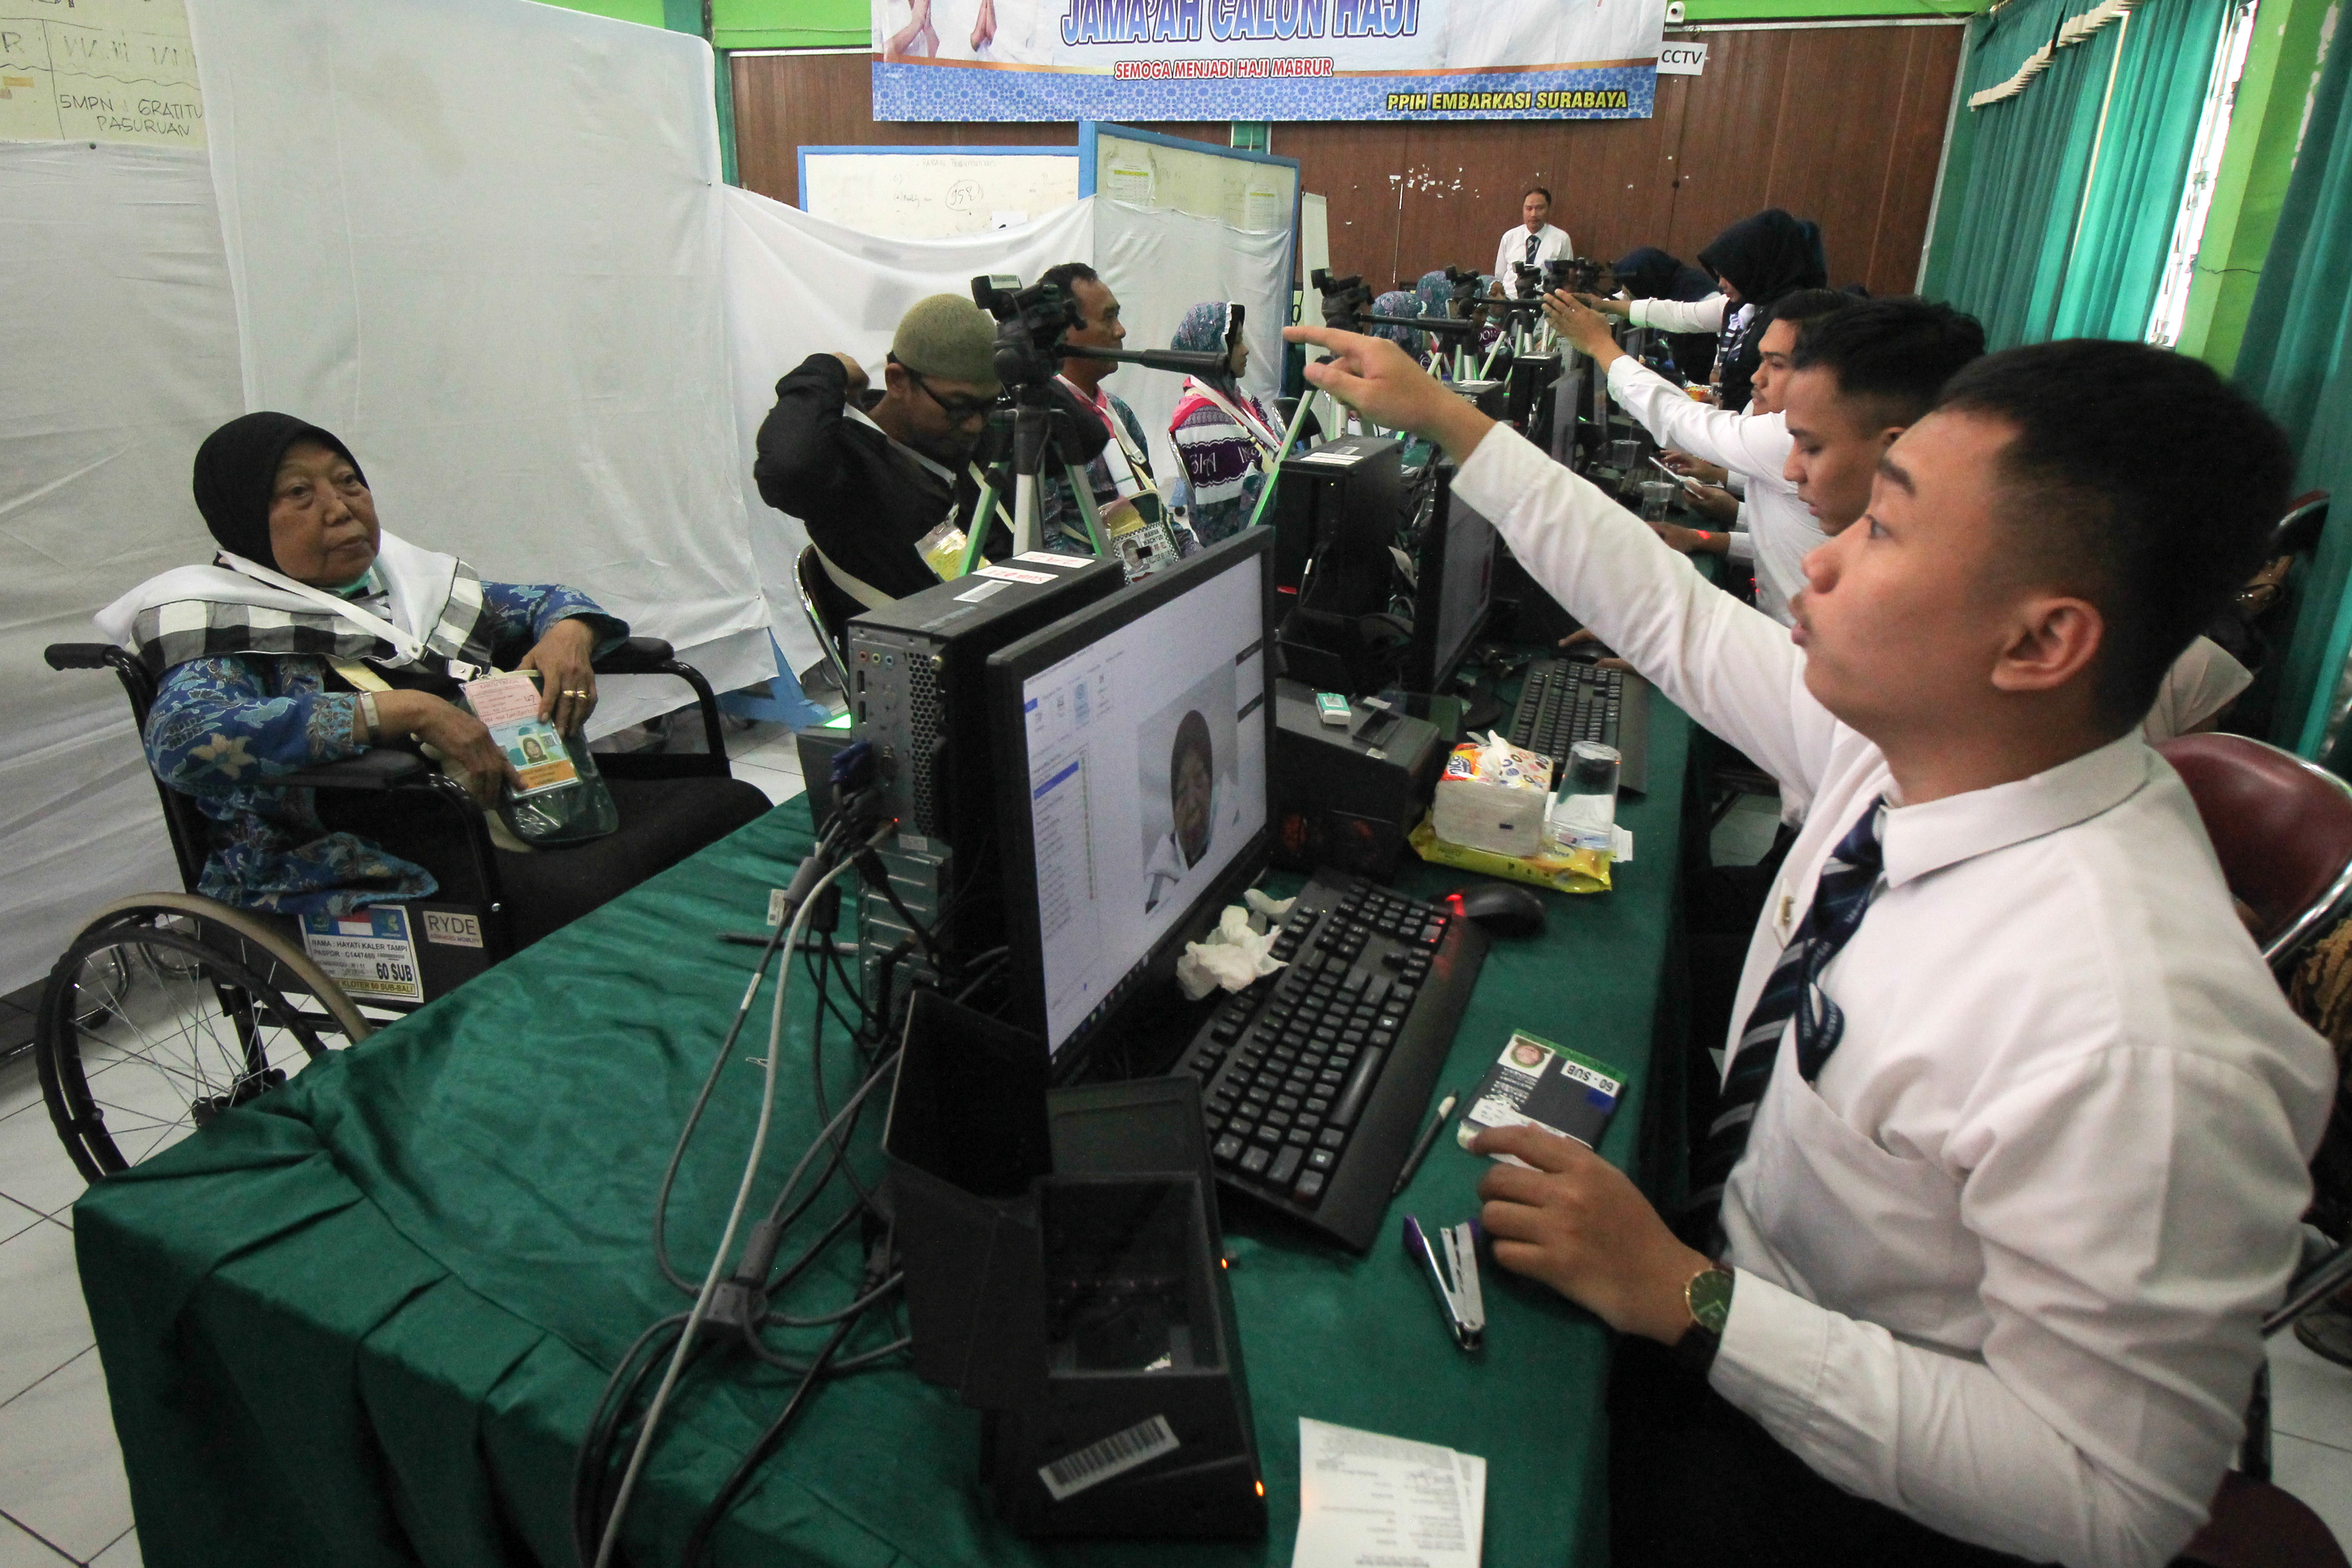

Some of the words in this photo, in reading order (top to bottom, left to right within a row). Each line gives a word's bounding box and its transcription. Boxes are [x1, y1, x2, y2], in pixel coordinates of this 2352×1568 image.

[1061, 0, 1201, 46] JAMA'AH
[1208, 0, 1324, 42] CALON
[1332, 0, 1418, 38] HAJI
[1661, 49, 1702, 66] CCTV
[1114, 60, 1172, 80] SEMOGA
[1174, 59, 1234, 79] MENJADI
[1236, 58, 1270, 78] HAJI
[1271, 56, 1334, 77] MABRUR
[1387, 93, 1428, 111] PPIH
[1431, 92, 1533, 111] EMBARKASI
[1535, 91, 1628, 110] SURABAYA
[97, 116, 189, 137] PASURUAN
[427, 915, 477, 935] RYDE
[336, 941, 361, 950] HAYATI
[362, 942, 385, 951] KALER
[376, 962, 390, 981] 60
[391, 964, 413, 981] SUB
[342, 979, 369, 989] KLOTER
[380, 983, 413, 992] SUB-BALI
[1566, 1065, 1591, 1081] SUB
[1598, 1078, 1614, 1092] 60
